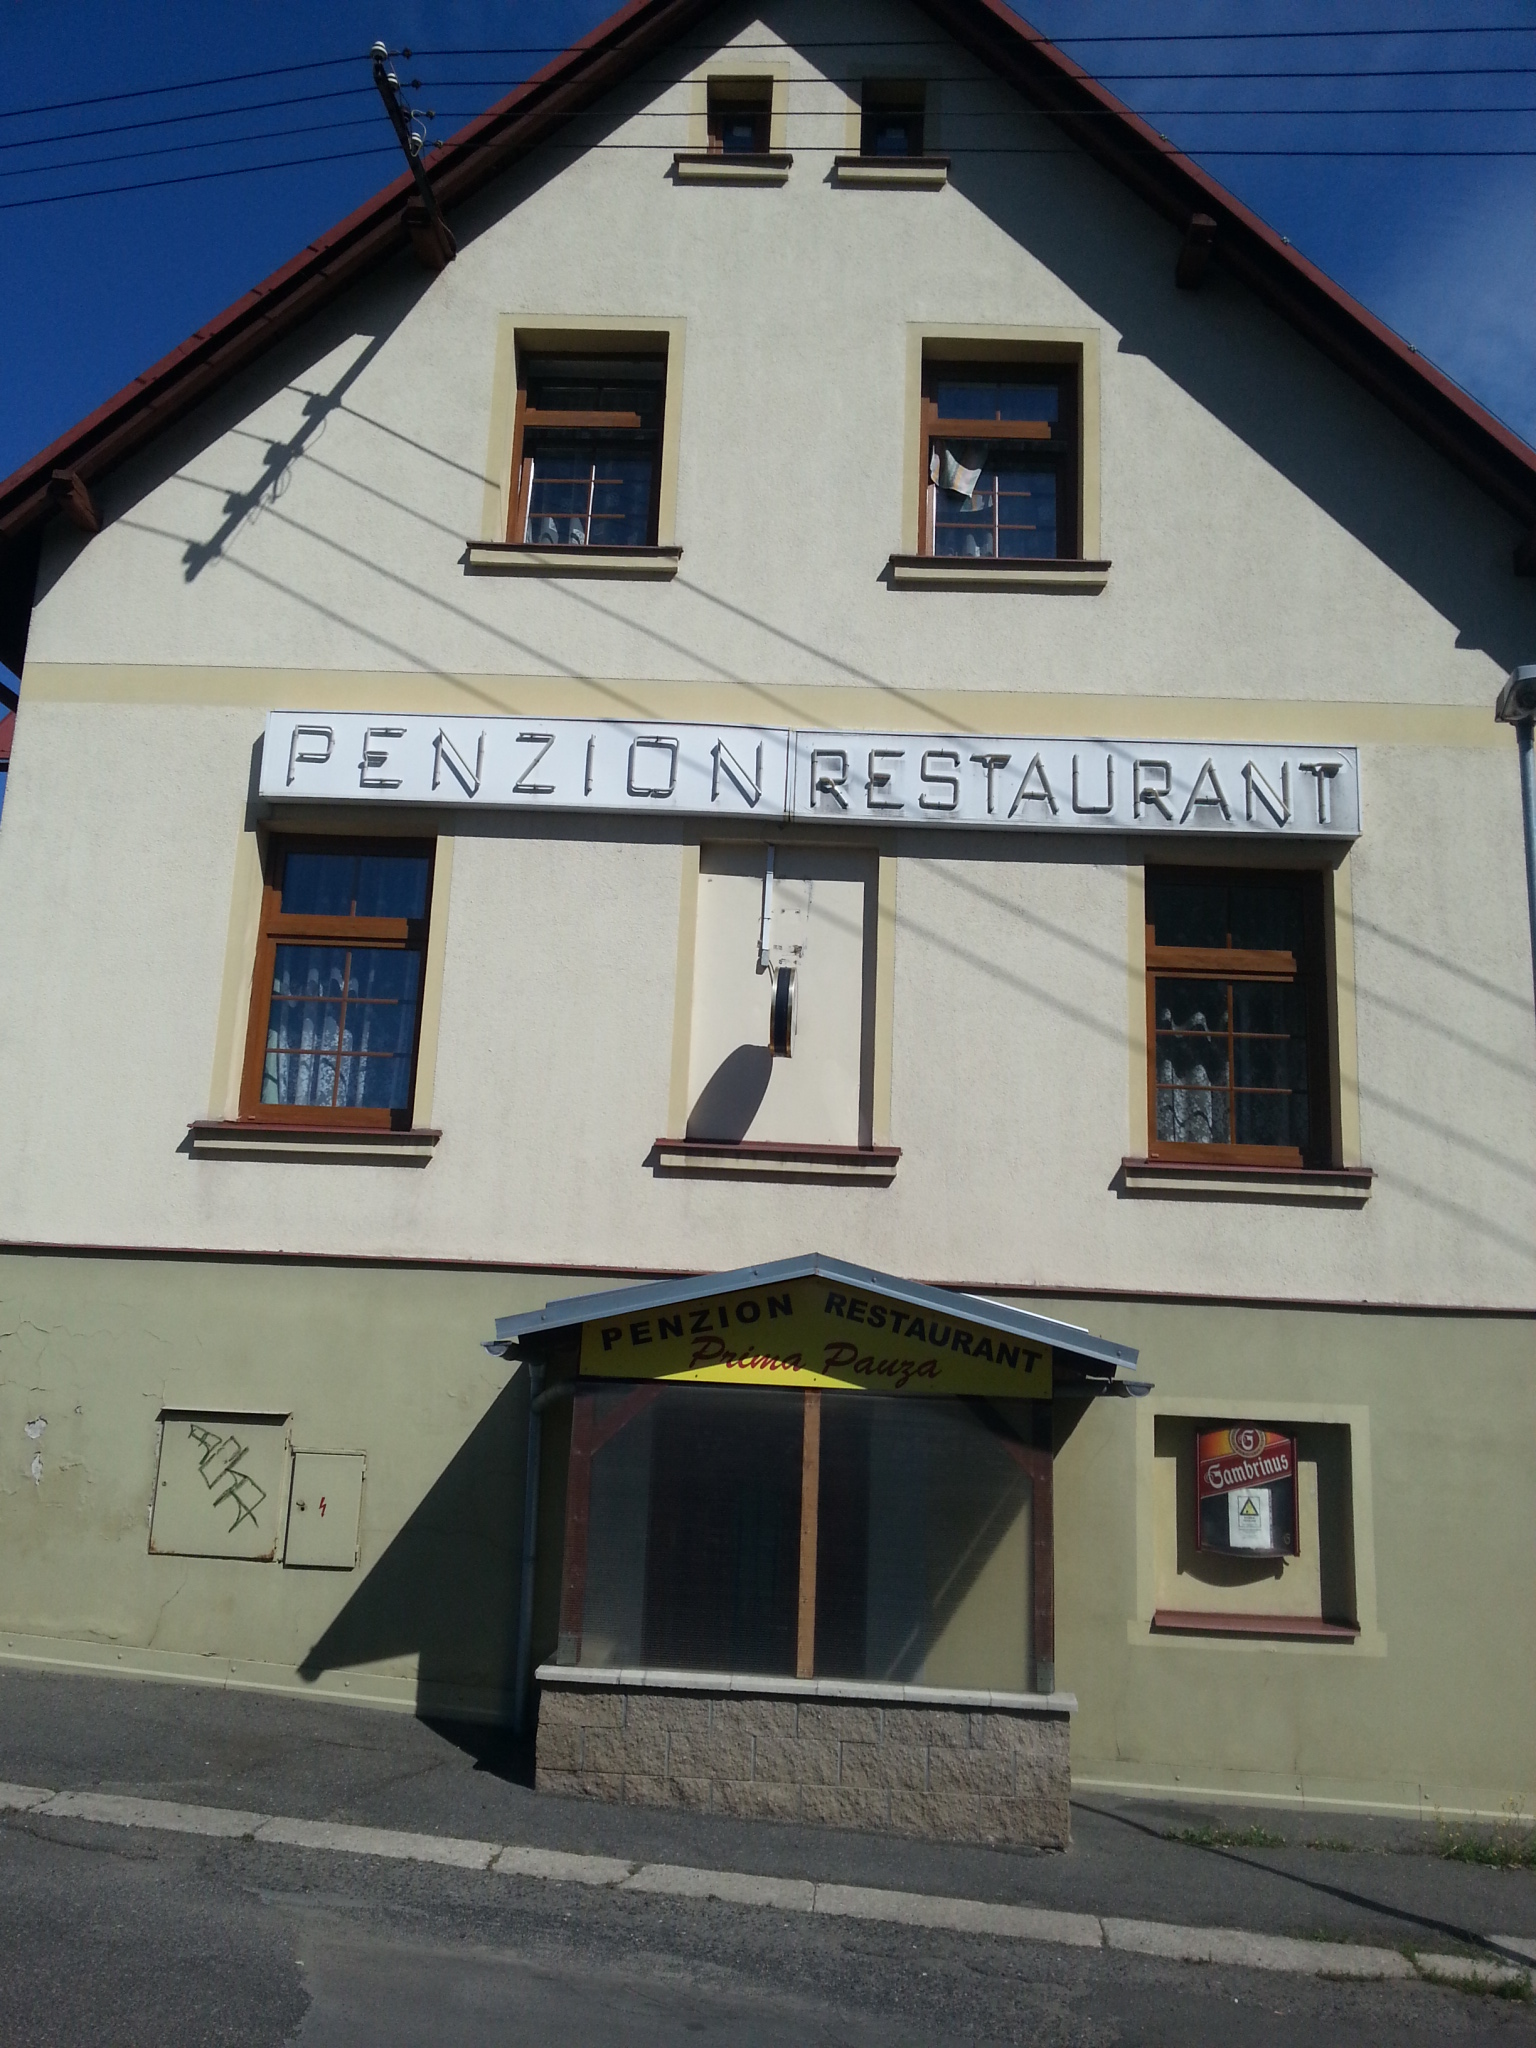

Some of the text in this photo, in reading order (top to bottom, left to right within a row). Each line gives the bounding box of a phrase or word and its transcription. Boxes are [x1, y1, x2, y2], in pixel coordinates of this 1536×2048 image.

[286, 724, 1344, 829] PENZION RESTAURANT
[601, 1292, 1043, 1373] PENZION RESTAURANT
[689, 1336, 942, 1389] Prima Pauza
[1204, 1453, 1290, 1489] Gambrinus
